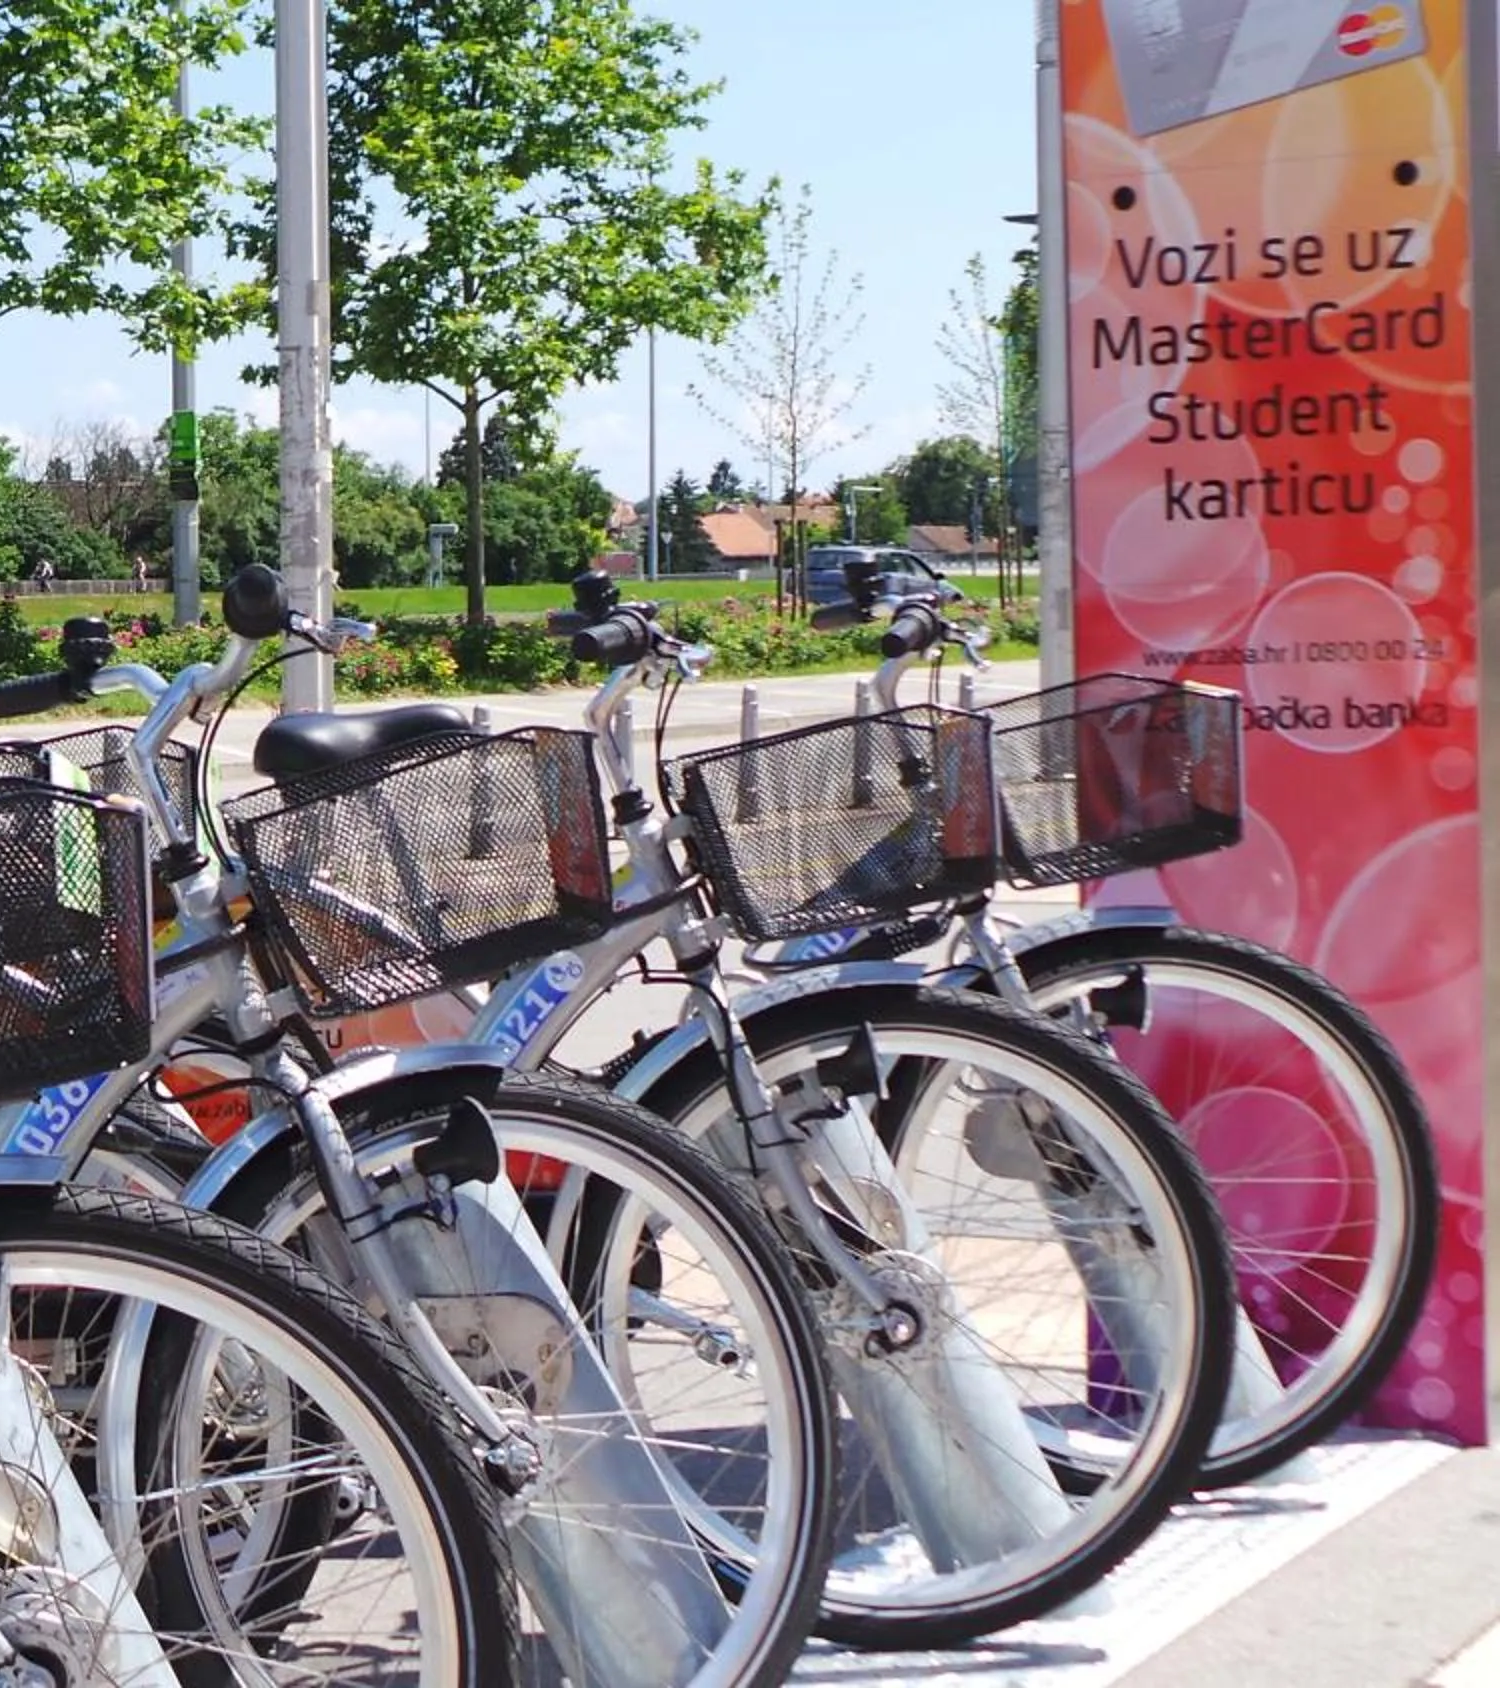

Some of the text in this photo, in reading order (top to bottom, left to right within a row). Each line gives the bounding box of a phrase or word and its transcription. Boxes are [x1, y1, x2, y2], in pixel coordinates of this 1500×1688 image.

[1116, 228, 1415, 290] Vozi se uz
[1091, 292, 1445, 369] MasterCard
[1148, 384, 1391, 444] Student
[1165, 466, 1376, 521] karticu
[1143, 642, 1287, 667] www.zaba.hr
[1307, 641, 1367, 664] 0800
[1374, 639, 1405, 660] 00
[1345, 696, 1448, 730] banka
[15, 1079, 89, 1155] 036
